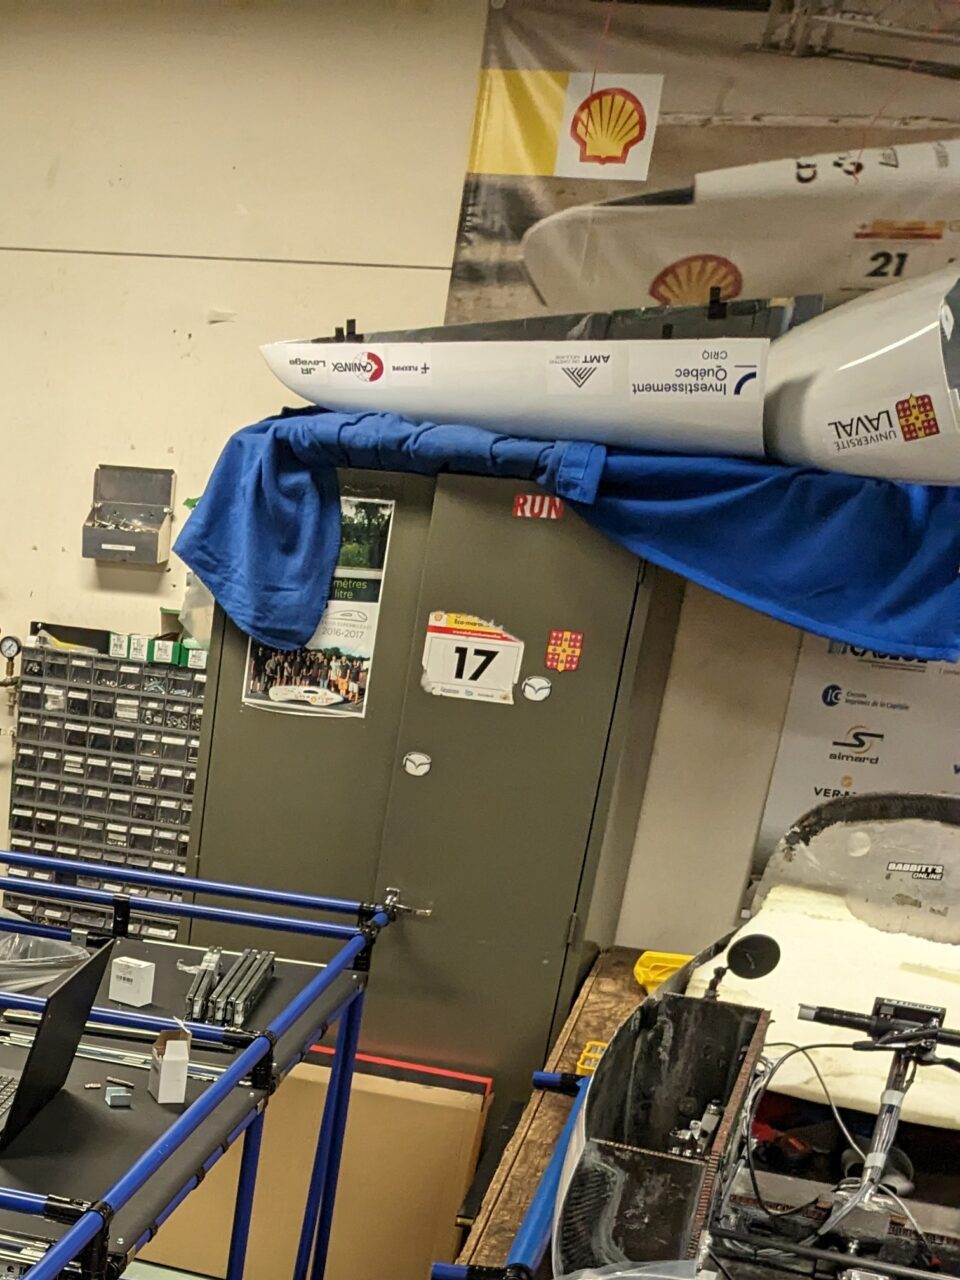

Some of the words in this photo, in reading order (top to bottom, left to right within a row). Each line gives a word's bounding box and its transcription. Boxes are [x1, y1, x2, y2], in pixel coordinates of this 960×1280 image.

[866, 251, 909, 277] 21
[582, 354, 610, 364] AMT
[702, 350, 728, 360] CRIQ
[301, 367, 316, 375] JR
[675, 366, 728, 382] Québec
[632, 383, 727, 396] Investissement
[828, 410, 894, 439] LAVAL
[834, 430, 897, 452] UNIVERSITÉ
[512, 495, 565, 520] RUN
[321, 627, 365, 639] 2016-2017
[455, 646, 499, 682] 17
[829, 752, 879, 764] simard
[913, 872, 942, 880] ONLINE
